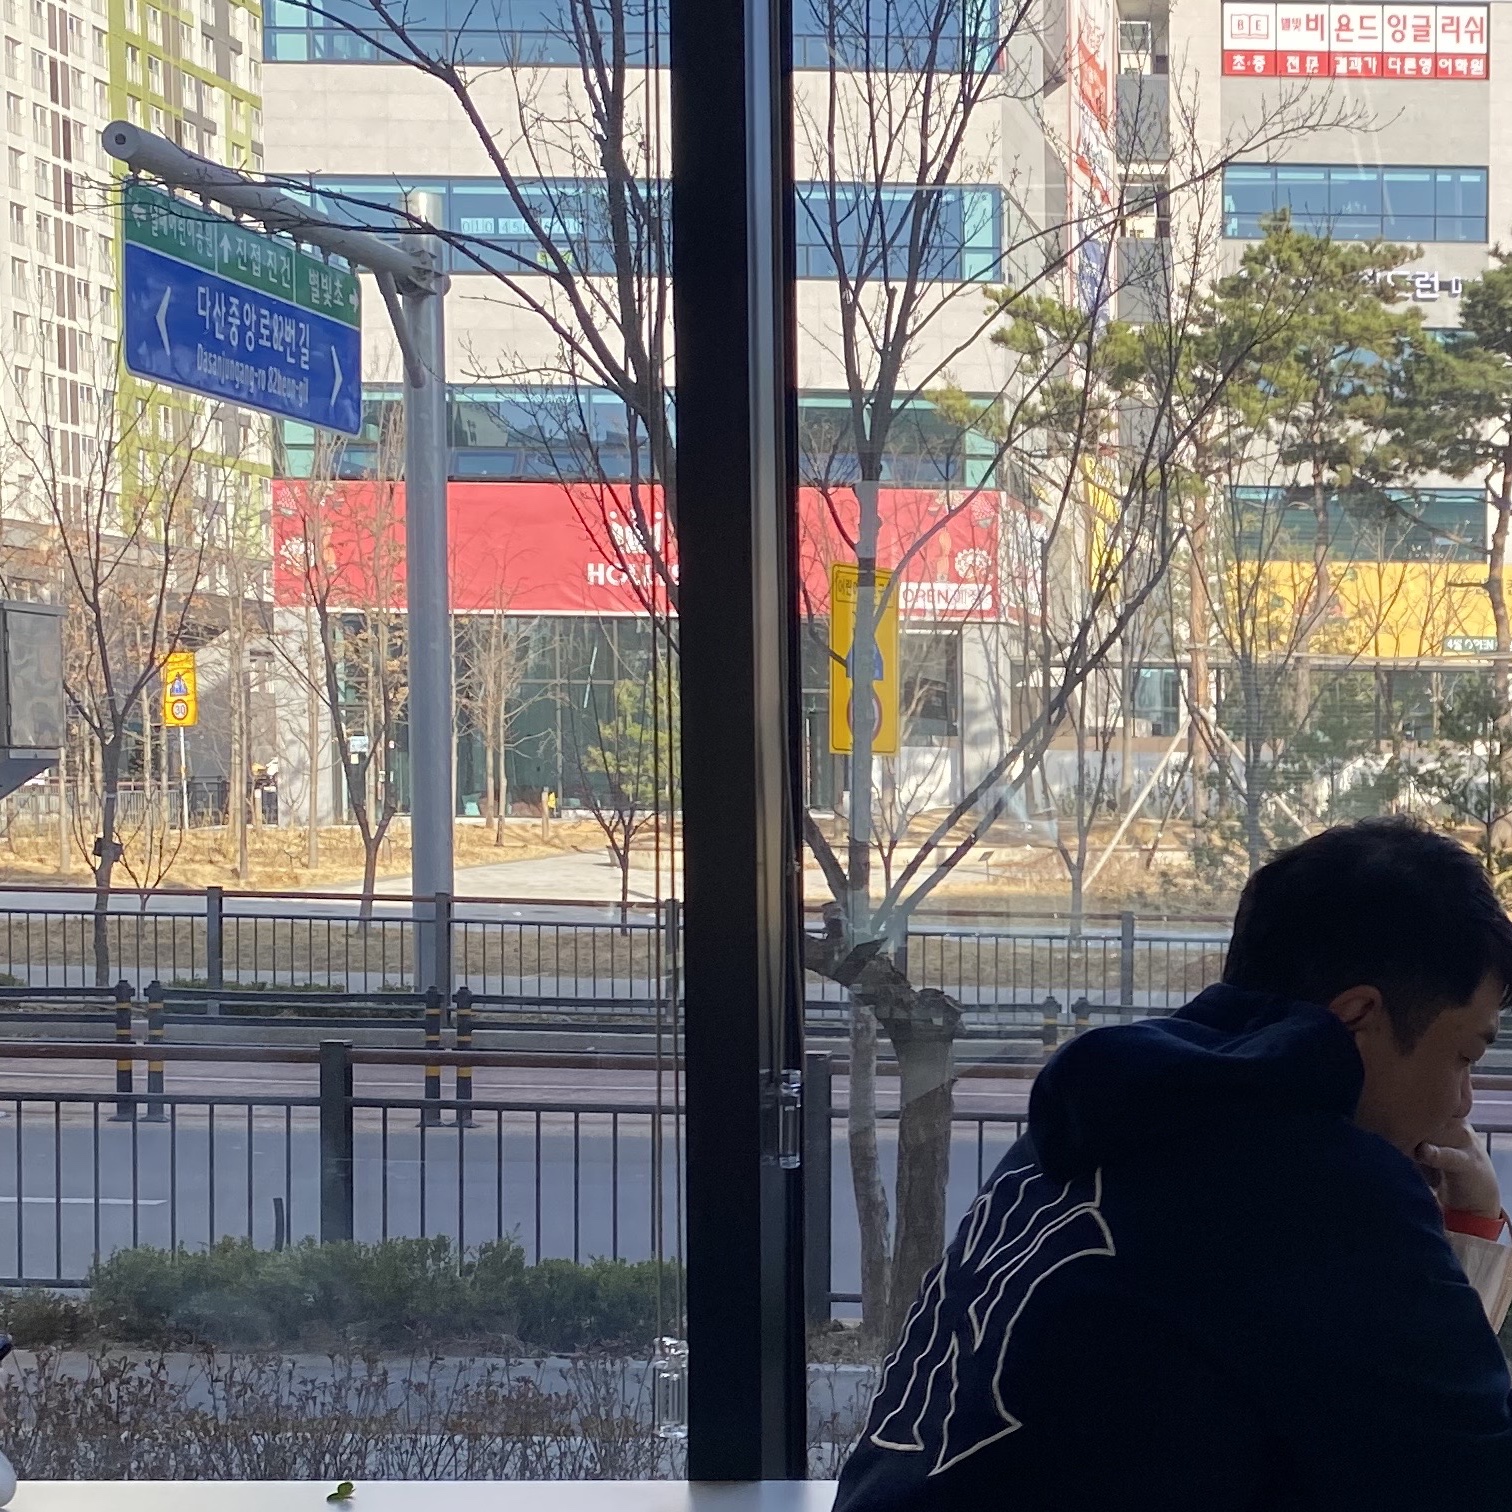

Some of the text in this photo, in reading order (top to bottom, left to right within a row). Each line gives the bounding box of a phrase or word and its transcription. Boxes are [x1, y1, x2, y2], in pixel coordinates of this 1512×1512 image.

[1305, 14, 1484, 44] 비욘드잉글리쉬
[235, 236, 262, 278] 진접
[197, 285, 310, 370] 다산중앙로82번길
[902, 588, 950, 604] OPEN
